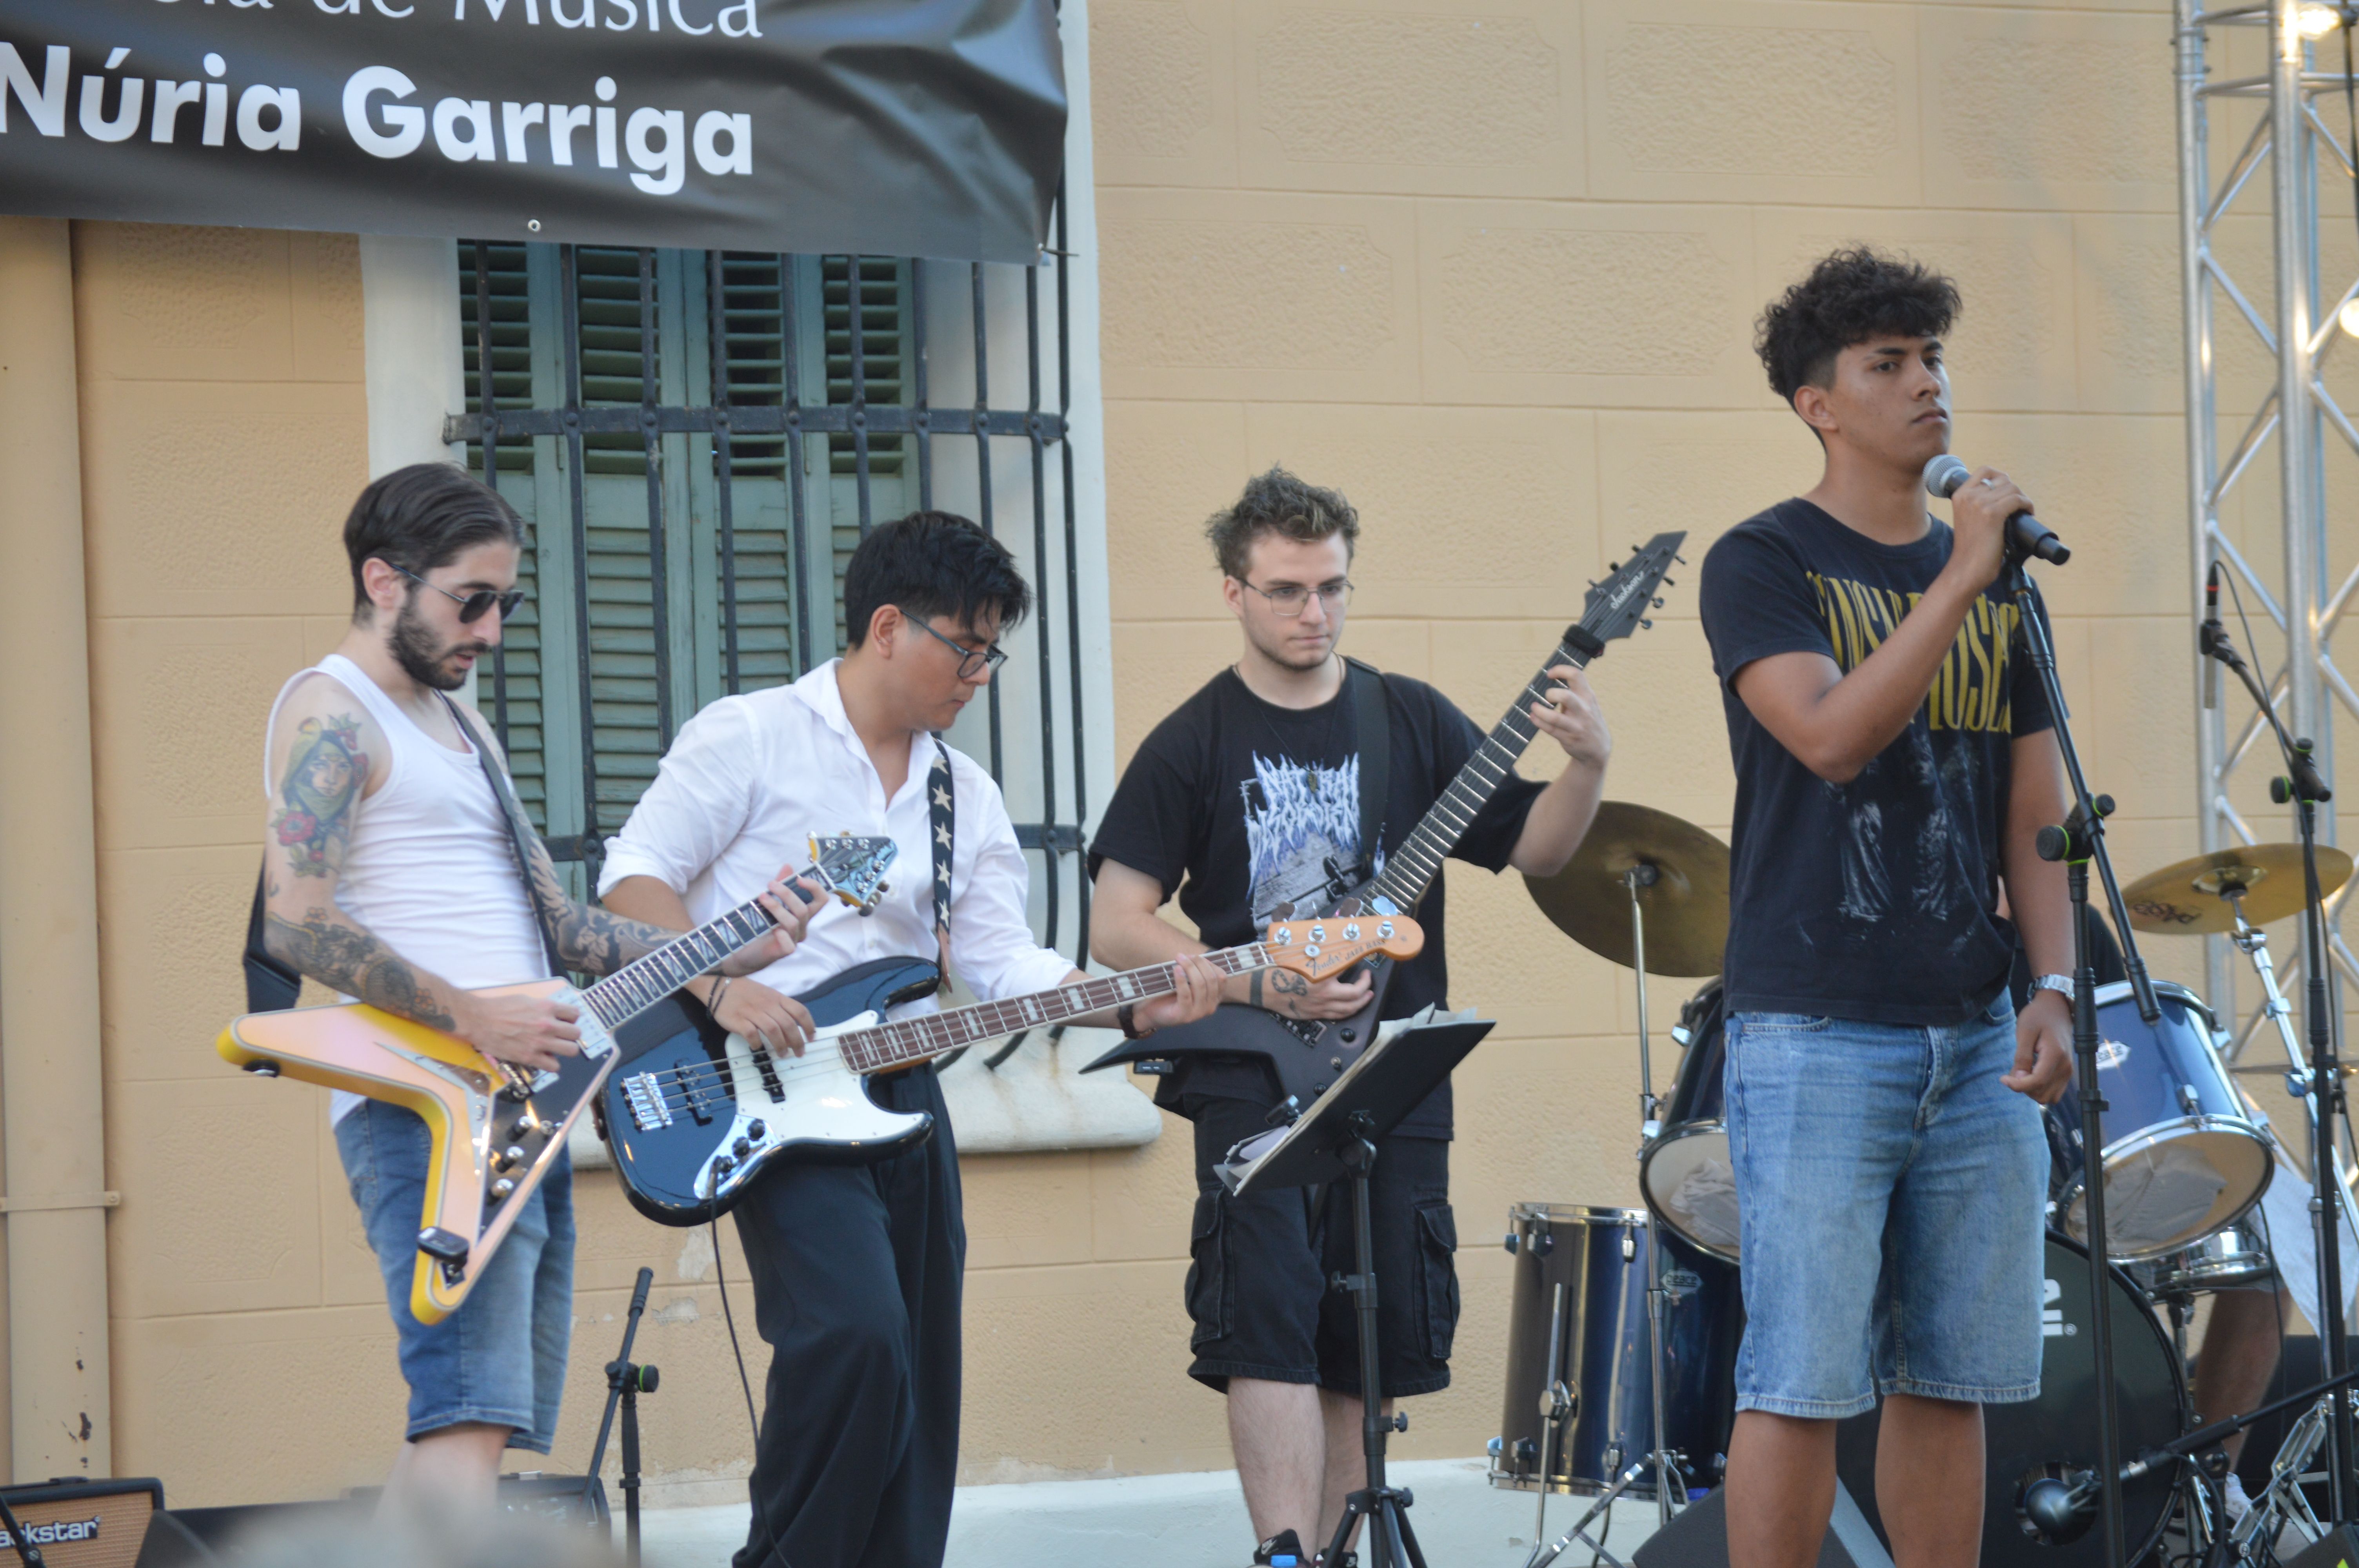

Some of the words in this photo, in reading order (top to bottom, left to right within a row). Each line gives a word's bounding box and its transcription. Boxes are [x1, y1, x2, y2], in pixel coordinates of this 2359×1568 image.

[0, 42, 302, 152] Núria
[342, 65, 752, 196] Garriga
[1305, 953, 1340, 976] Fender
[1345, 946, 1364, 960] JAZZ
